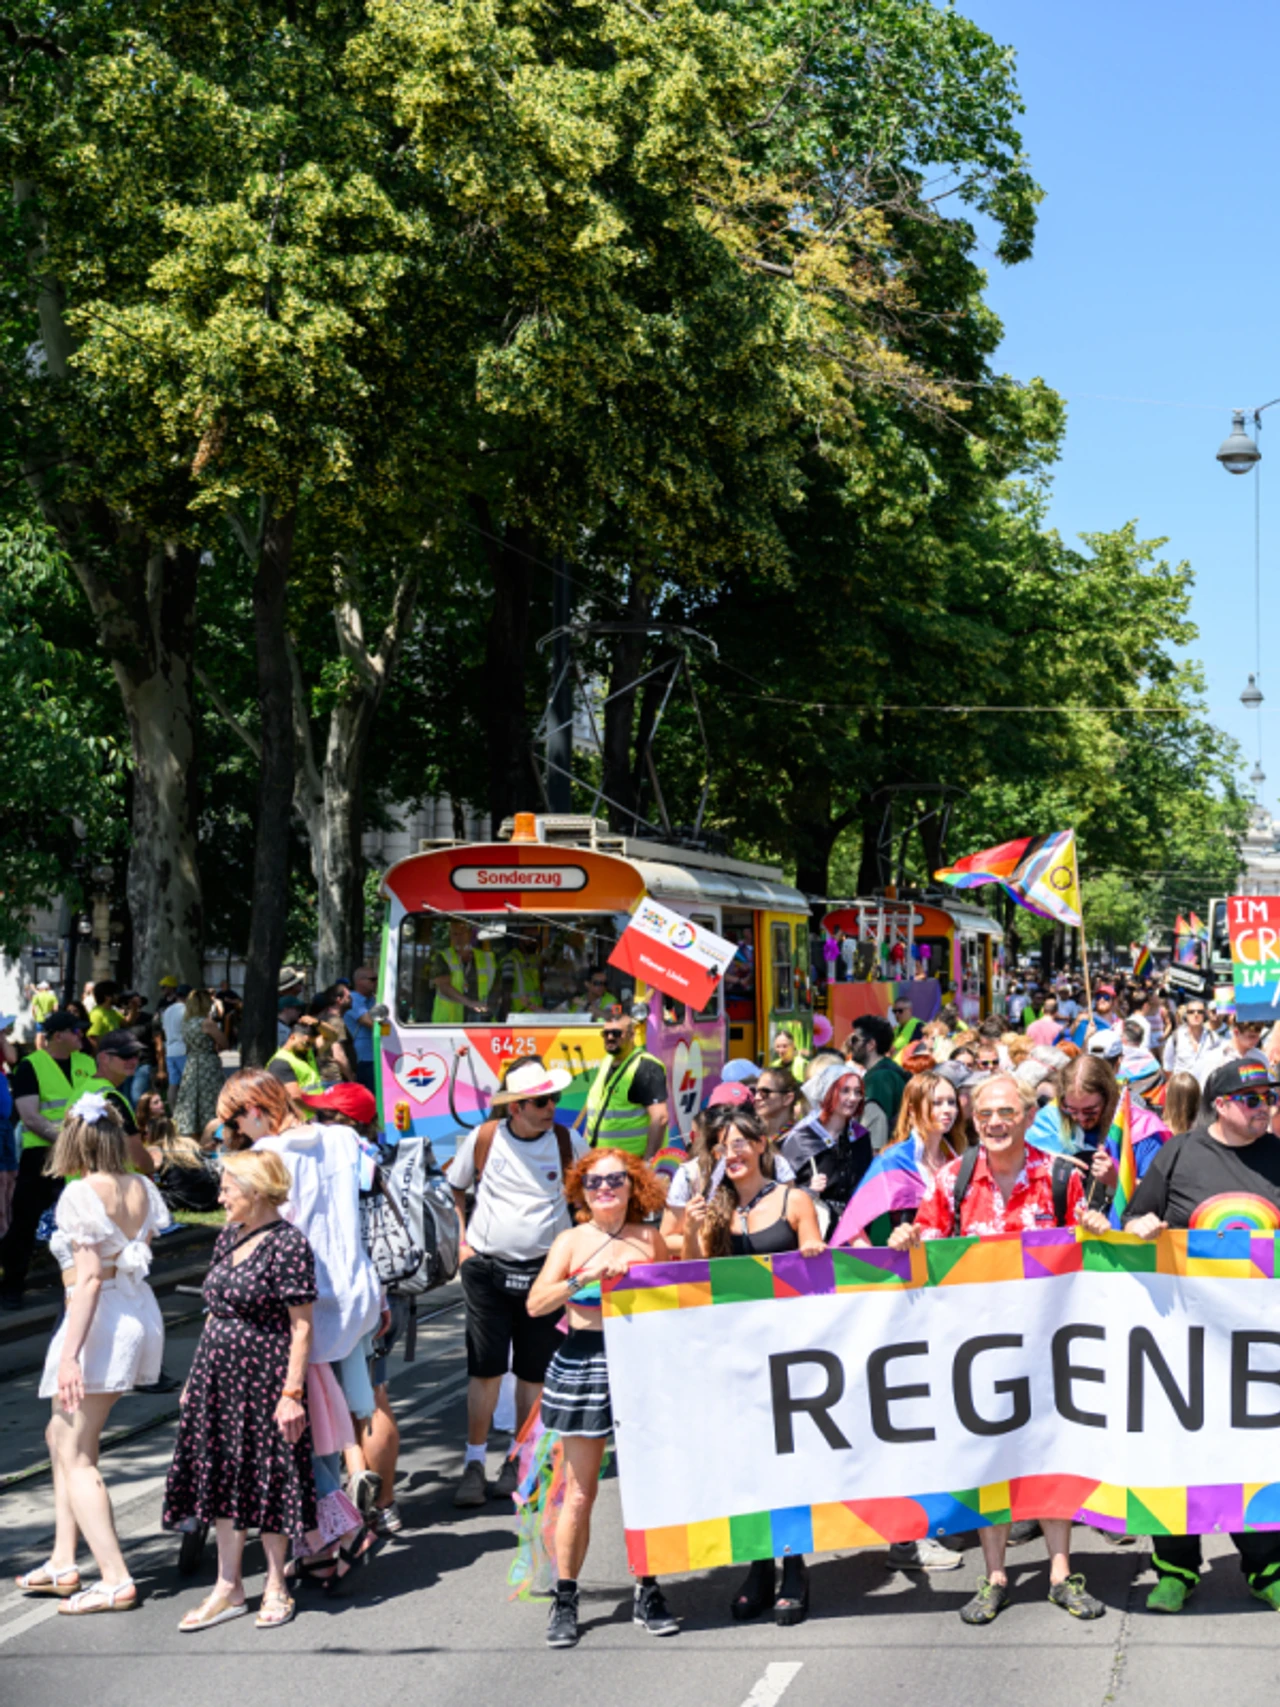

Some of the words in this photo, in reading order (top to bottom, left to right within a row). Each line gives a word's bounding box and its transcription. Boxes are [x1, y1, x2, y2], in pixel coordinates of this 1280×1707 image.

[477, 870, 562, 888] Sonderzug
[1234, 898, 1269, 923] I'M
[1241, 968, 1266, 987] IN
[491, 1036, 537, 1055] 6425
